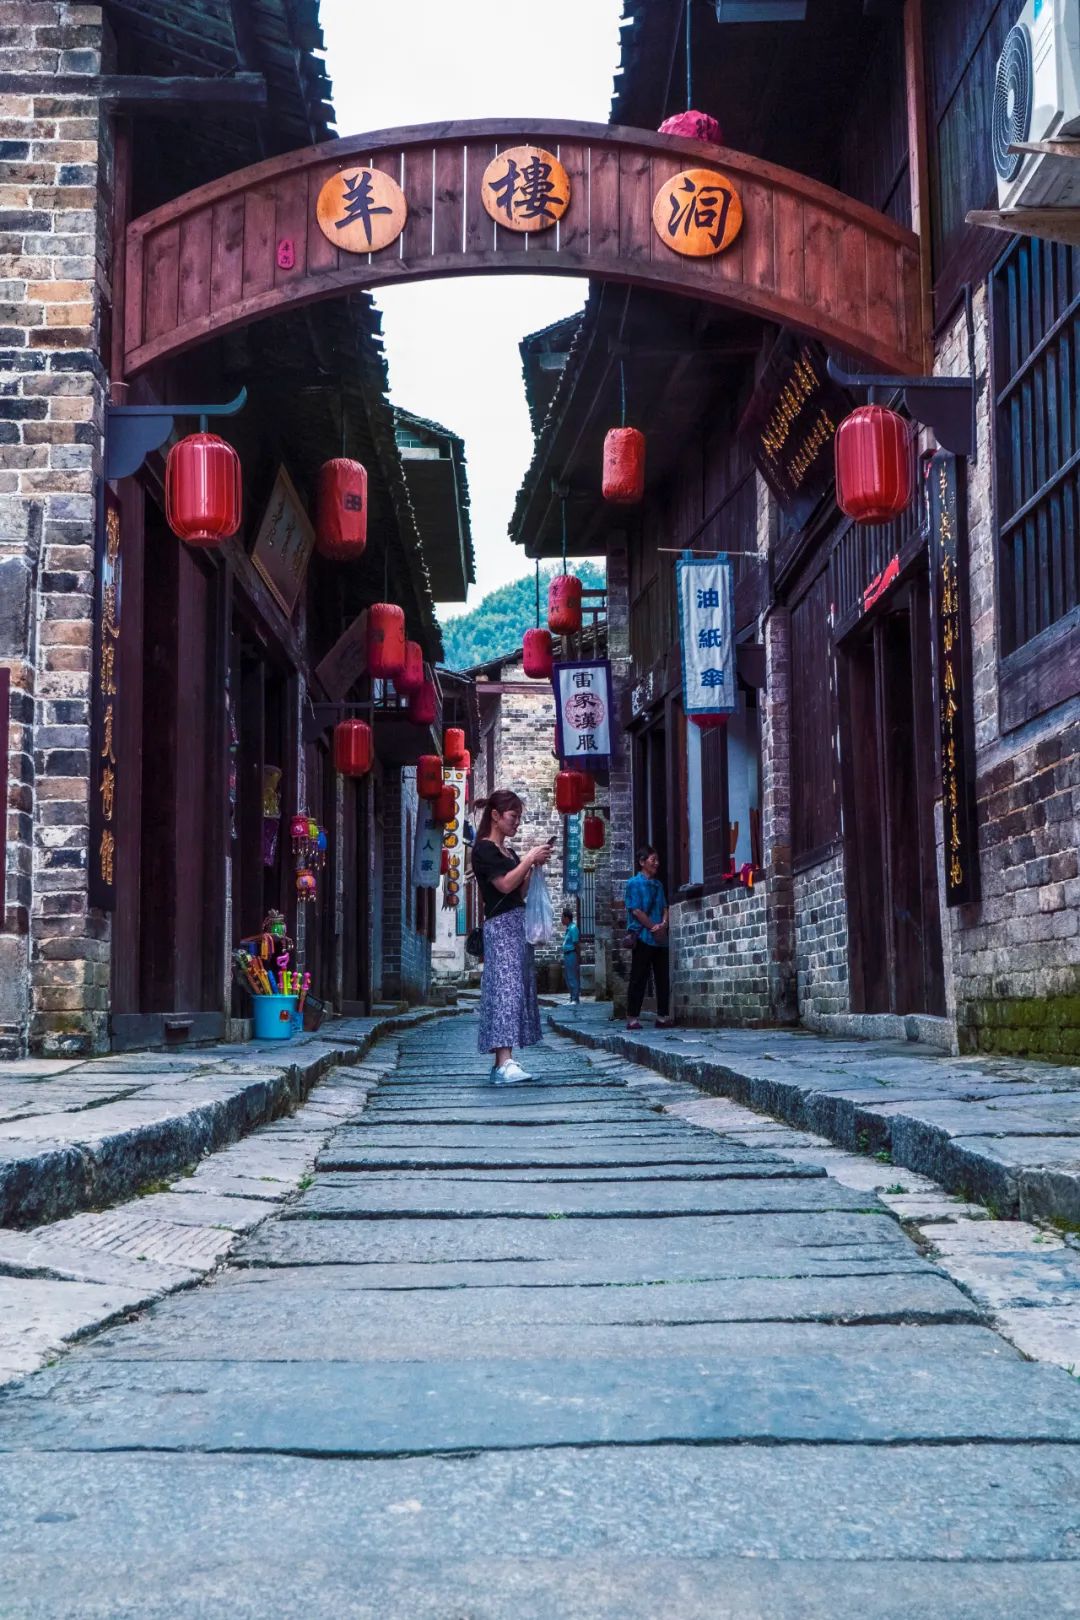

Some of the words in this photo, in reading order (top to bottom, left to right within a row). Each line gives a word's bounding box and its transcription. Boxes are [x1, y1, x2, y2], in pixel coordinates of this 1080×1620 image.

[335, 156, 732, 248] 羊樓洞
[696, 588, 725, 688] 油紙傘
[572, 671, 599, 751] 雷家漢服
